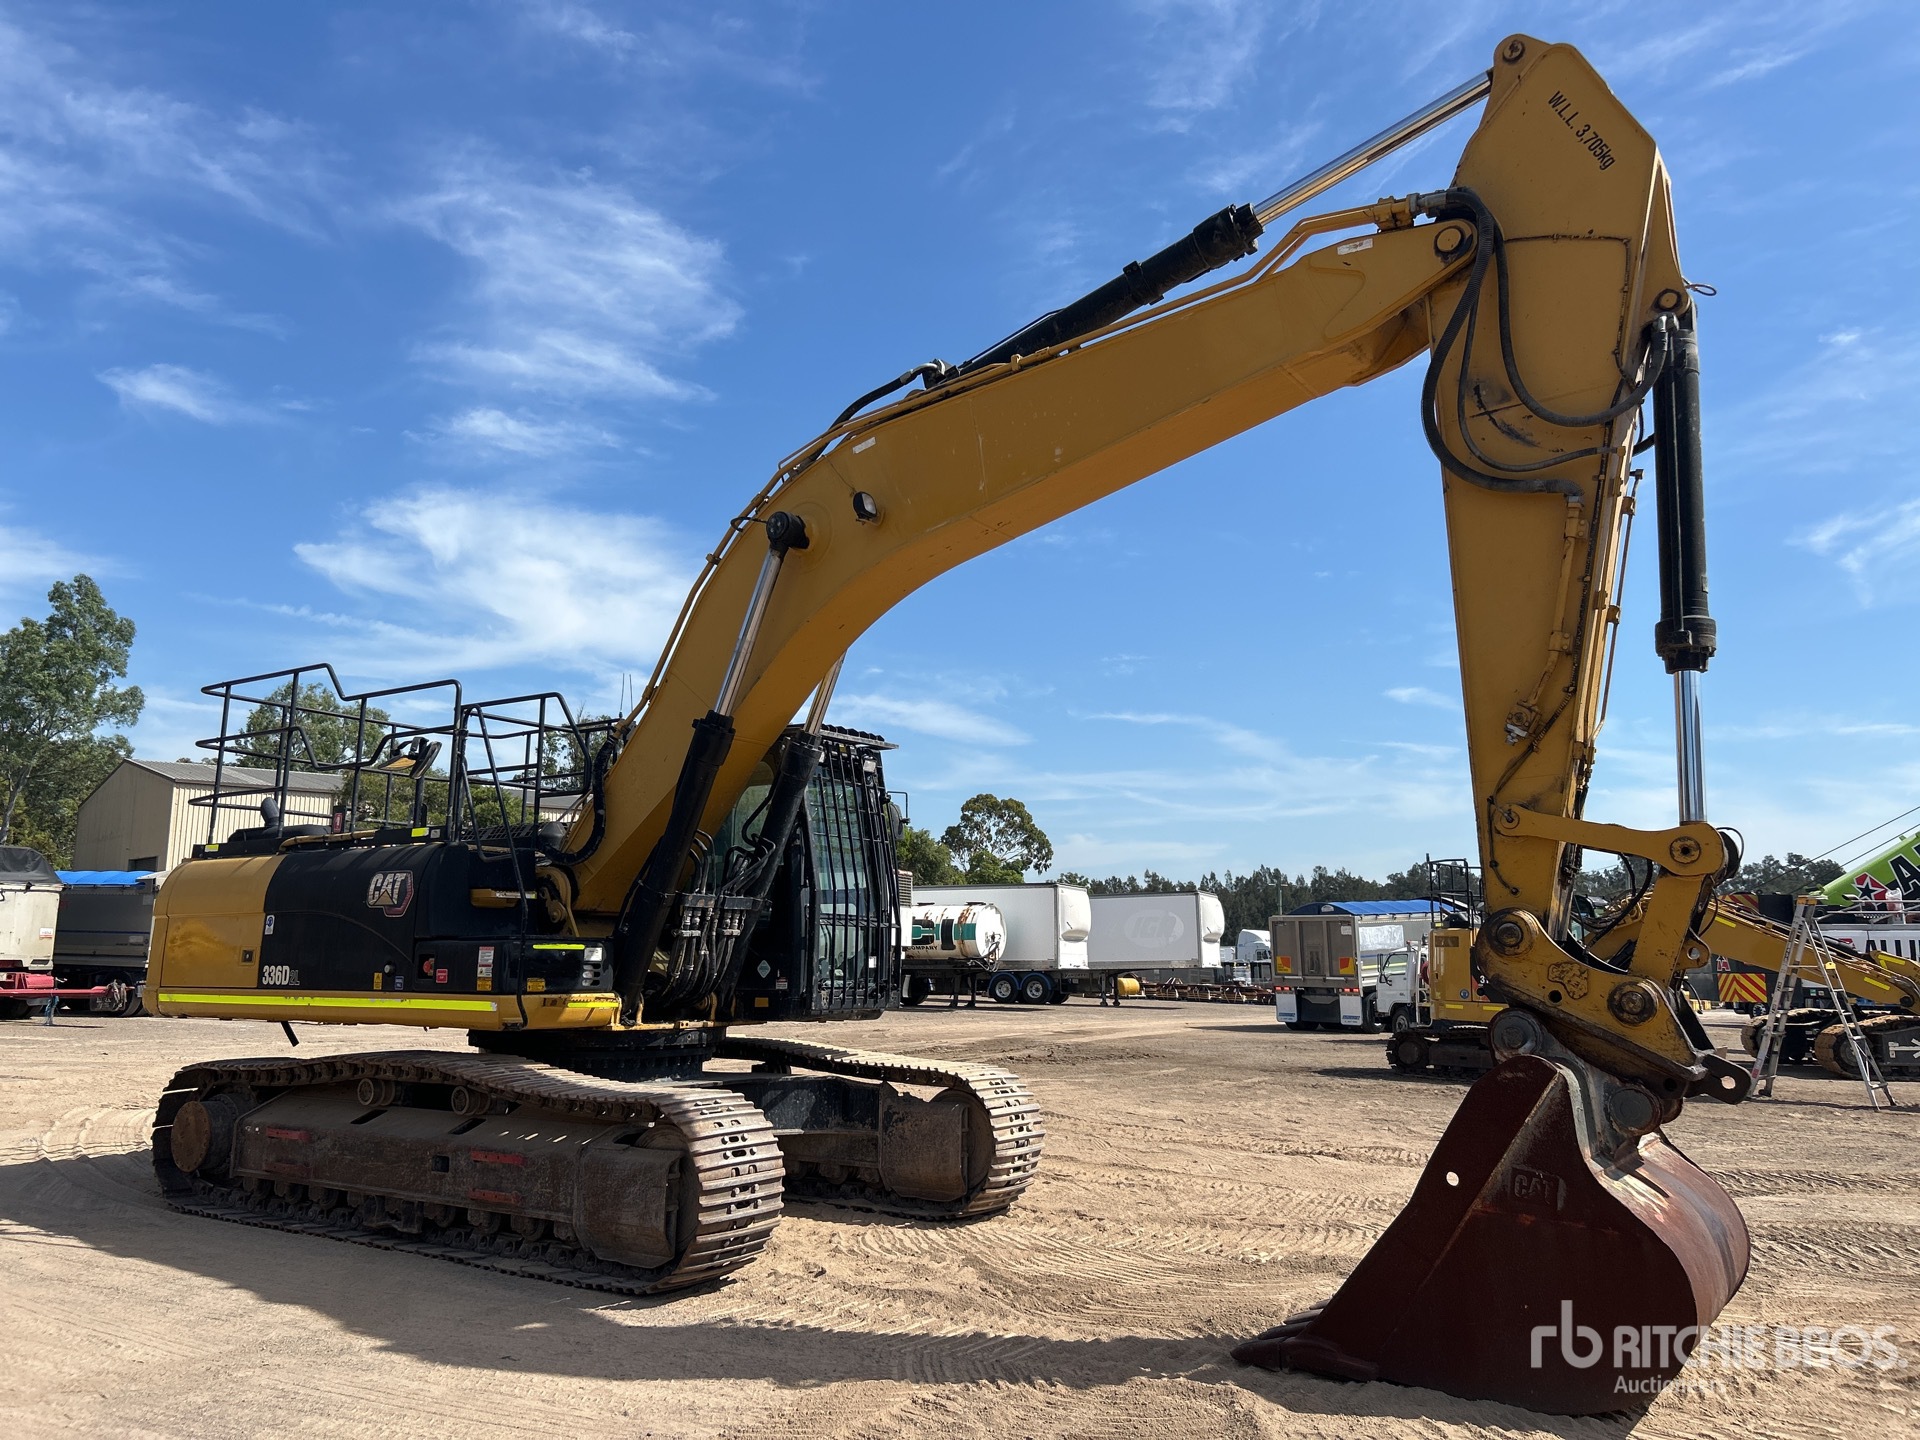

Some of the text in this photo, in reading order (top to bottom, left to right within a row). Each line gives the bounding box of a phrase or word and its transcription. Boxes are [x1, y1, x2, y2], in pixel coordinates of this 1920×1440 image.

[1548, 90, 1616, 171] W.L.L. 3,705kg
[368, 873, 407, 905] CAT
